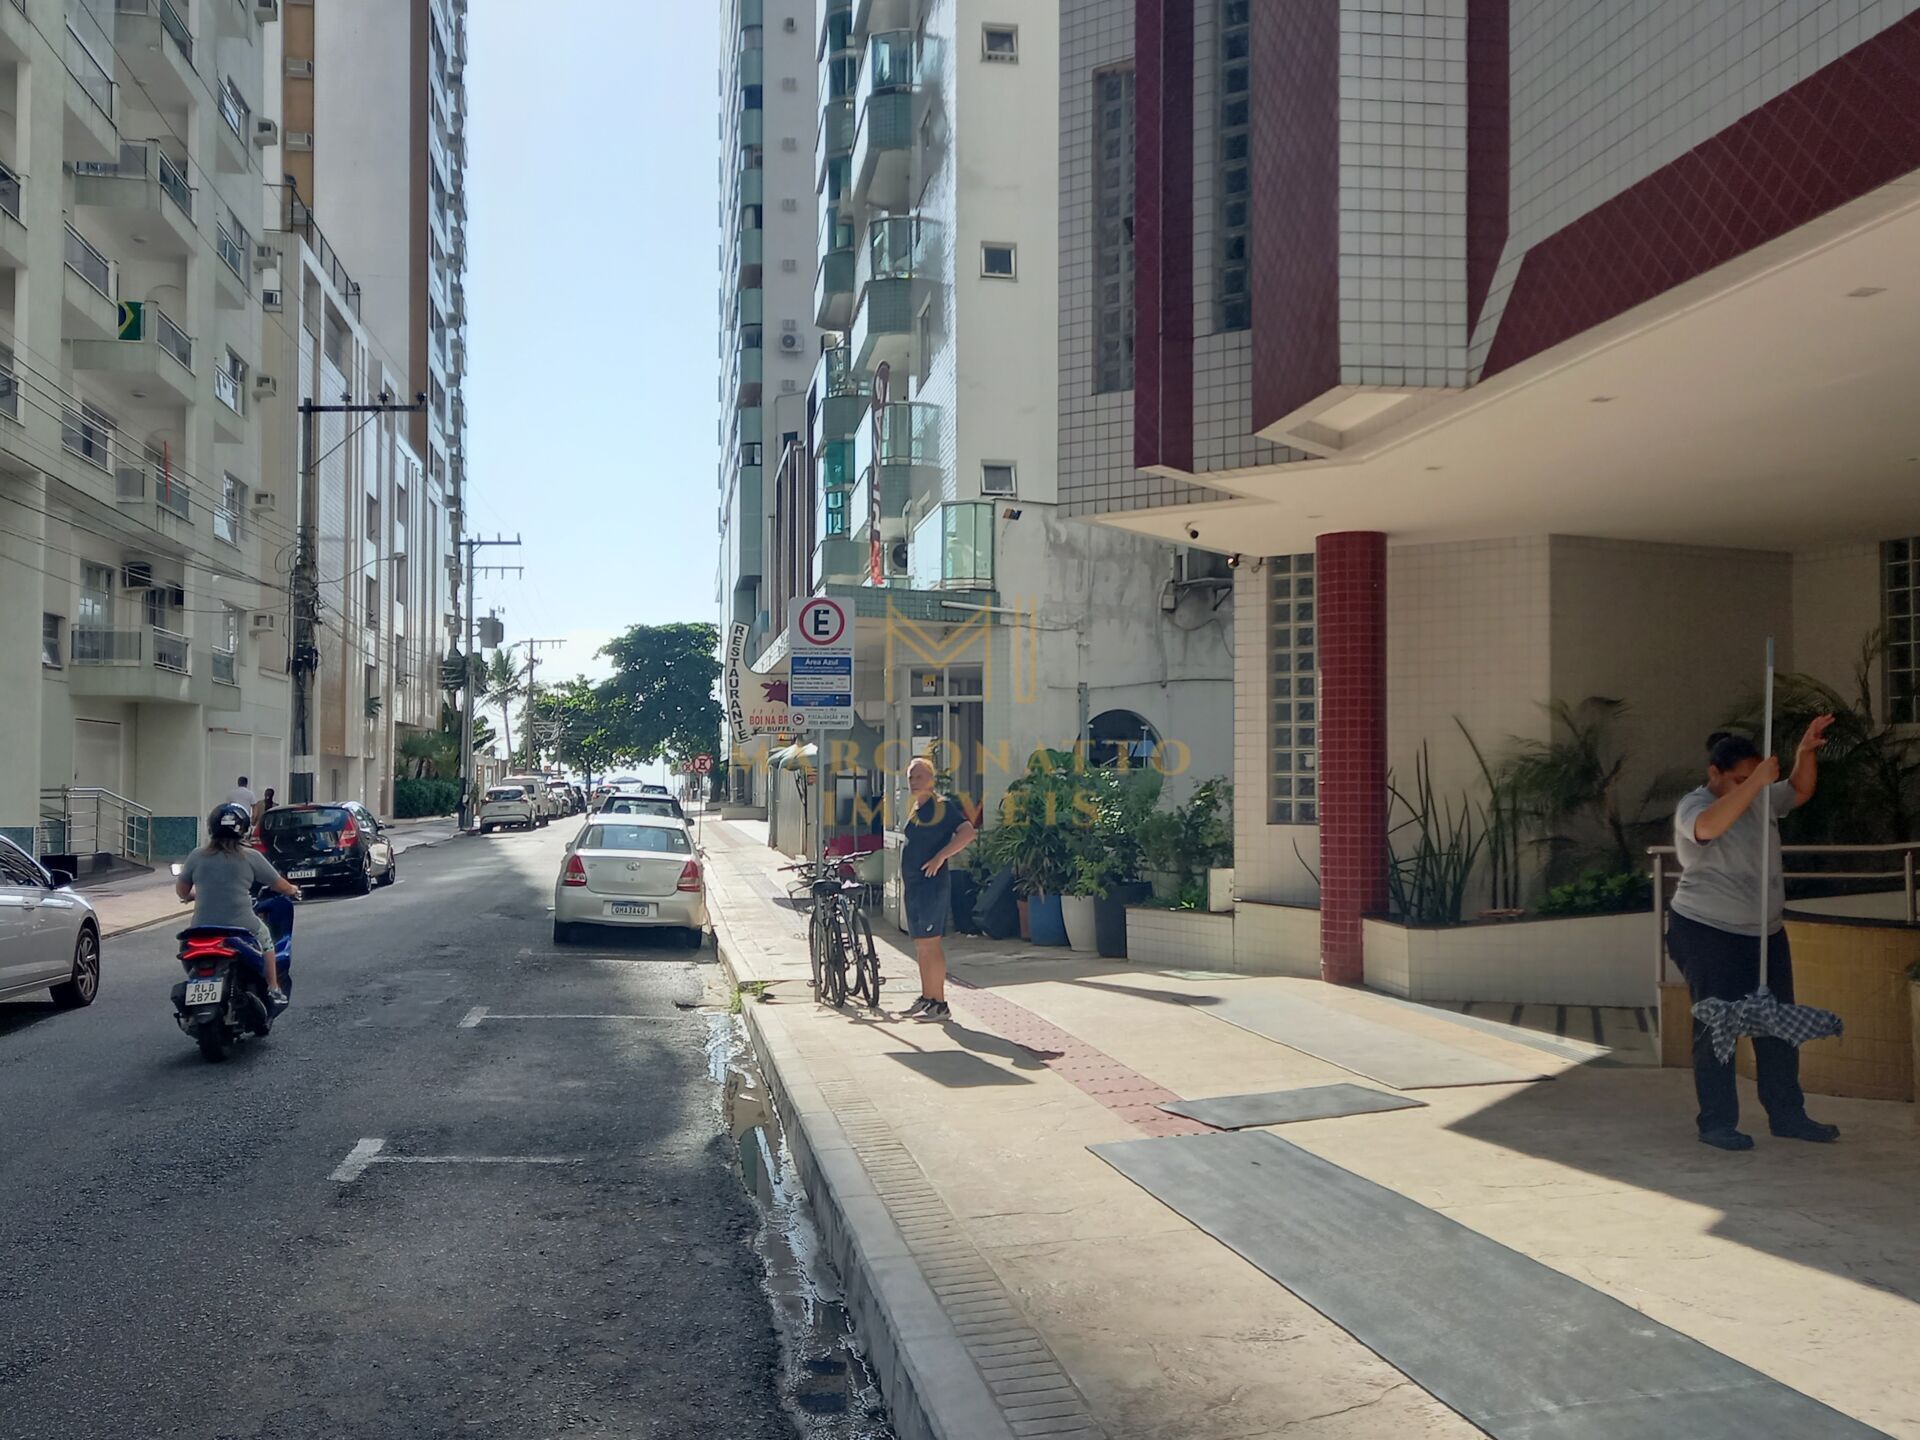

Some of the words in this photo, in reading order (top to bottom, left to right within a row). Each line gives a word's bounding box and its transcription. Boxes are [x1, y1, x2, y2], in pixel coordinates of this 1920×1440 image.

[813, 609, 830, 636] E
[804, 657, 821, 666] Área
[823, 658, 839, 666] Azul
[728, 624, 749, 741] RESTAURANTE
[749, 715, 763, 726] BOI
[765, 715, 776, 726] NA
